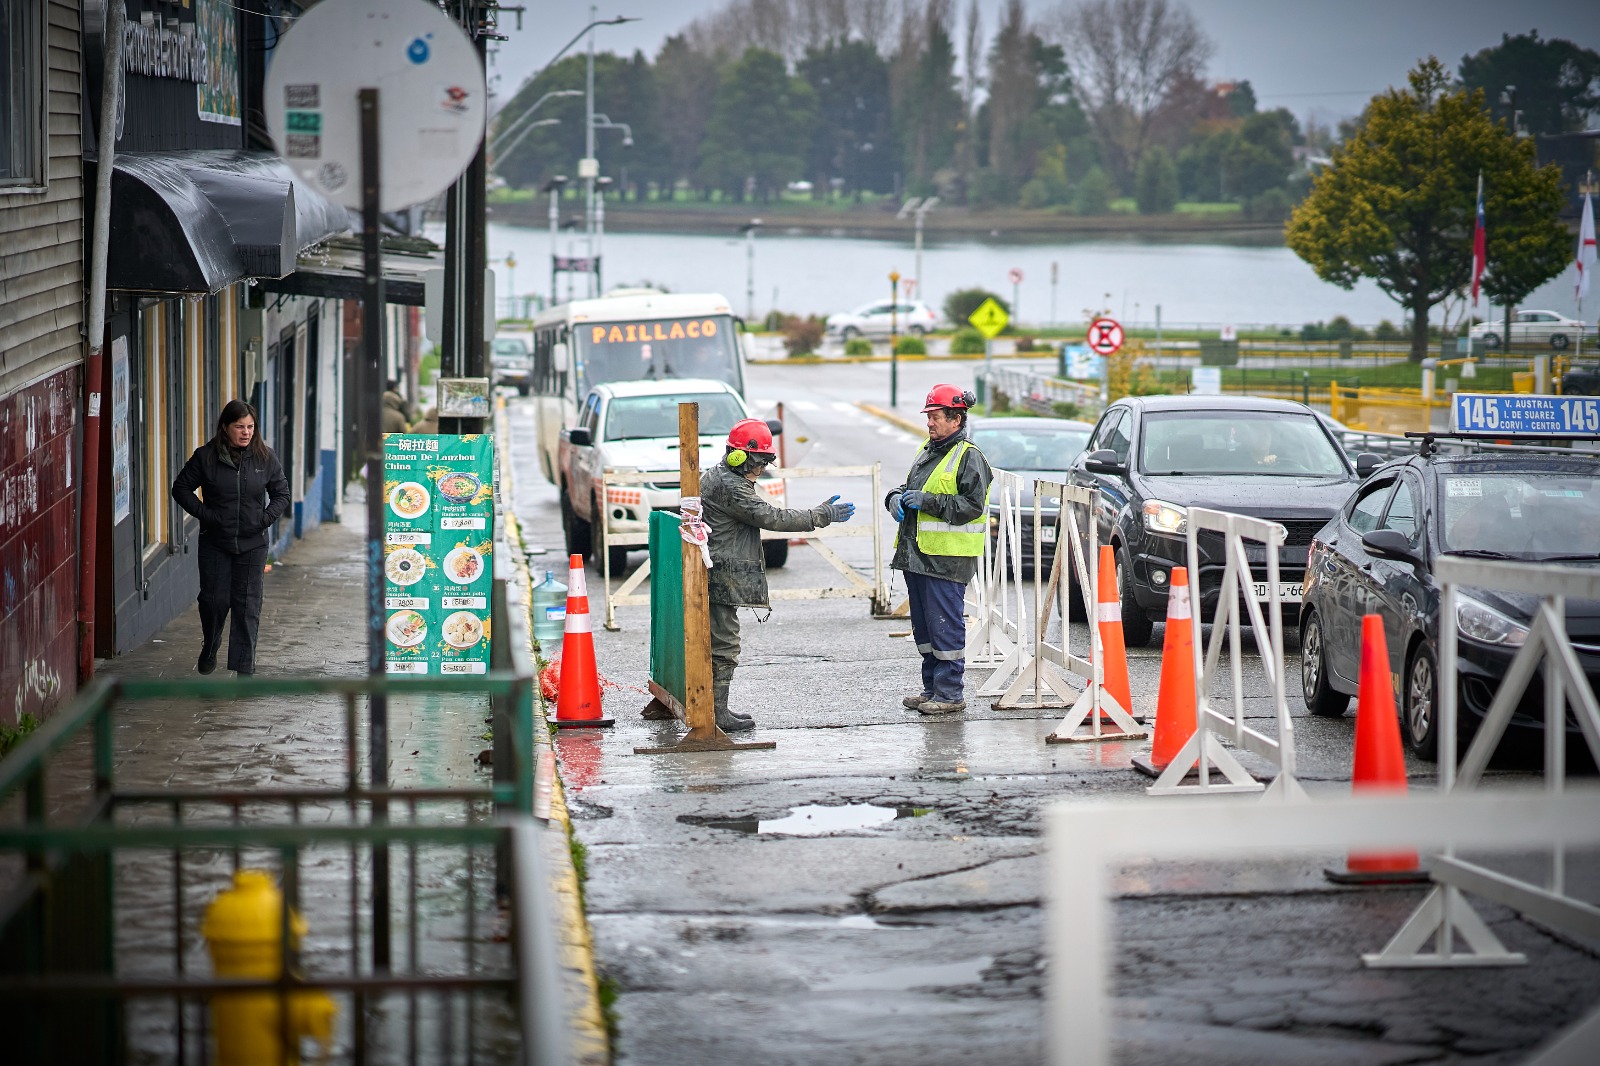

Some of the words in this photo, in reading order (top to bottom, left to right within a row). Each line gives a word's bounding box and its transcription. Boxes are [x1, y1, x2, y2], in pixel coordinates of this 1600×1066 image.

[592, 320, 716, 344] PAILLACO
[1516, 400, 1553, 408] AUSTRAL
[1461, 398, 1499, 429] 145
[1525, 411, 1555, 419] SUAREZ
[1561, 401, 1599, 430] 145
[1500, 421, 1523, 429] CORVI
[1531, 422, 1560, 430] CENTRO
